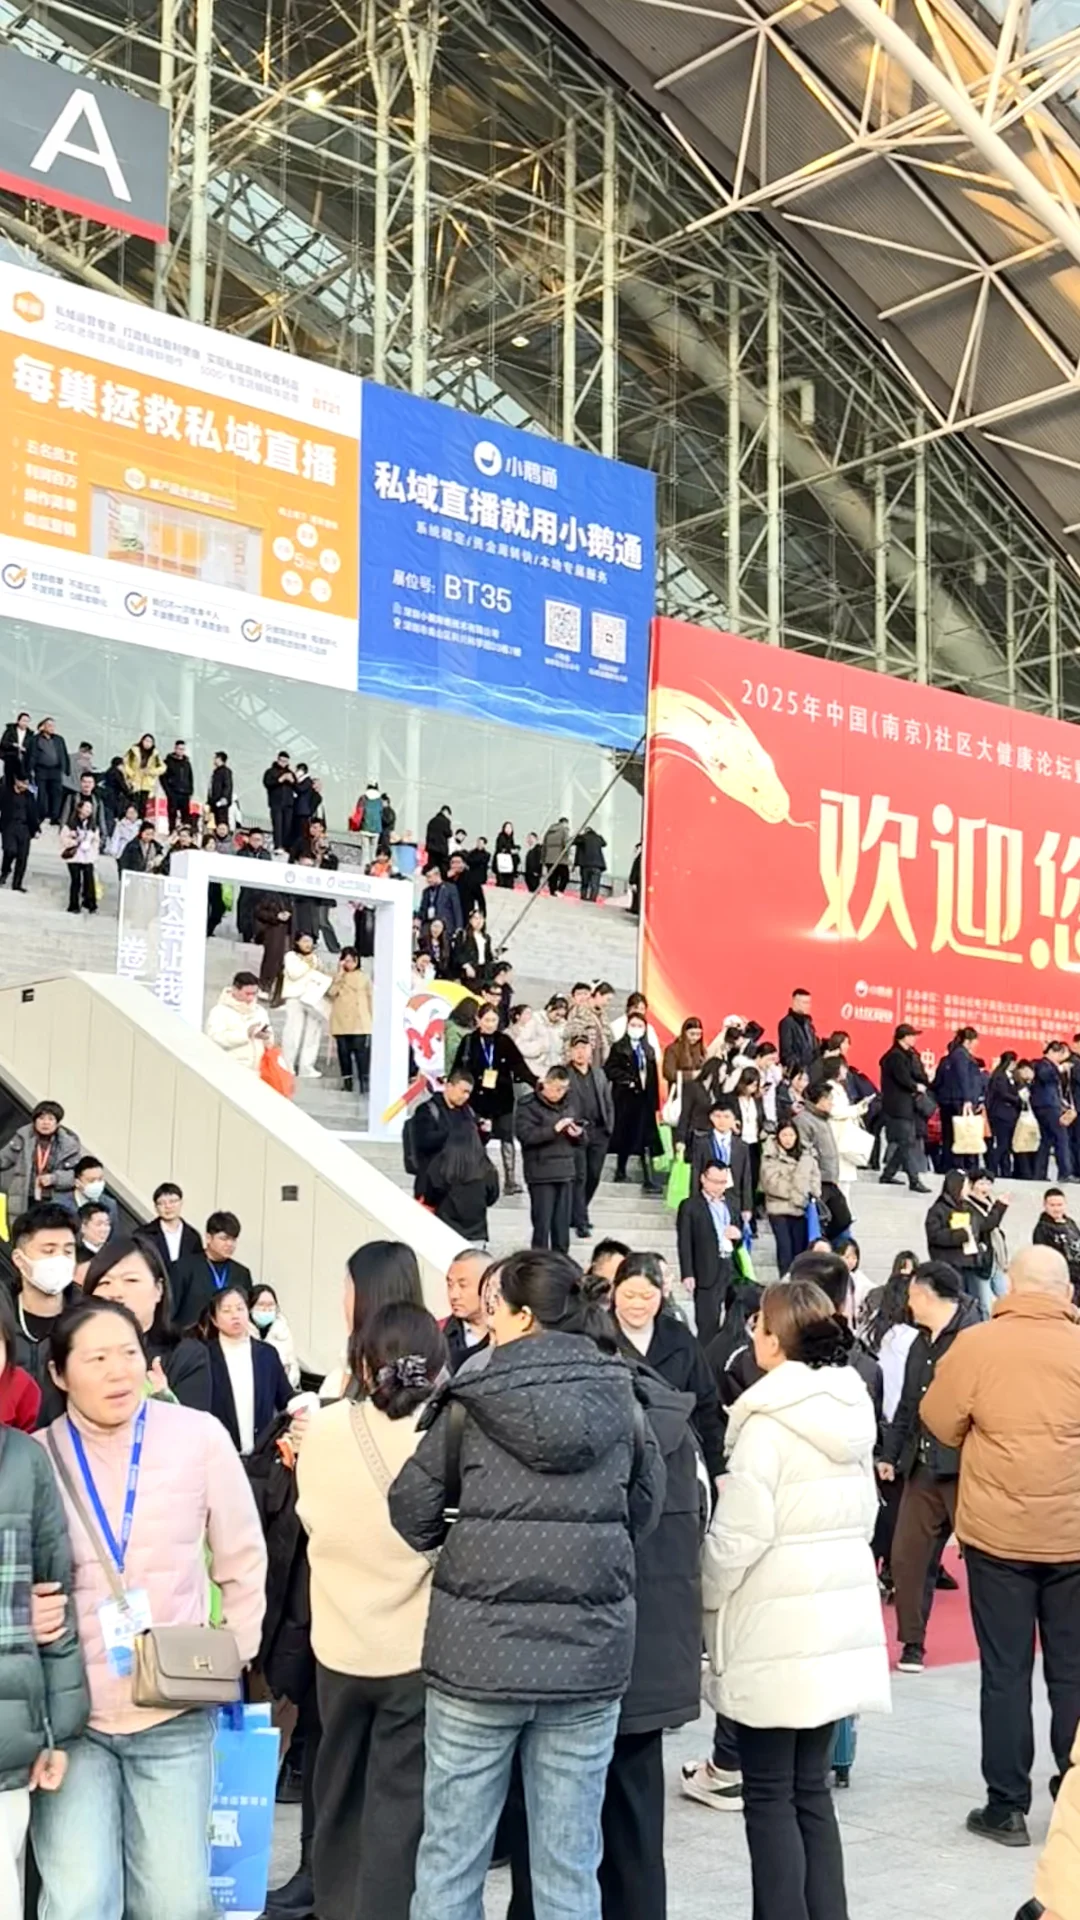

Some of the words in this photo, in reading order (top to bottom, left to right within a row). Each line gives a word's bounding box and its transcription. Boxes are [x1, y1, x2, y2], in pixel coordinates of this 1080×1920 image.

[30, 88, 131, 202] A
[13, 354, 337, 487] 每巢拯救私域直播
[312, 397, 341, 415] BT21
[374, 461, 643, 570] 私域直播就用小鹅通
[444, 573, 512, 613] BT35
[741, 679, 1080, 782] 2025年中国(南京)社区大健康论坛
